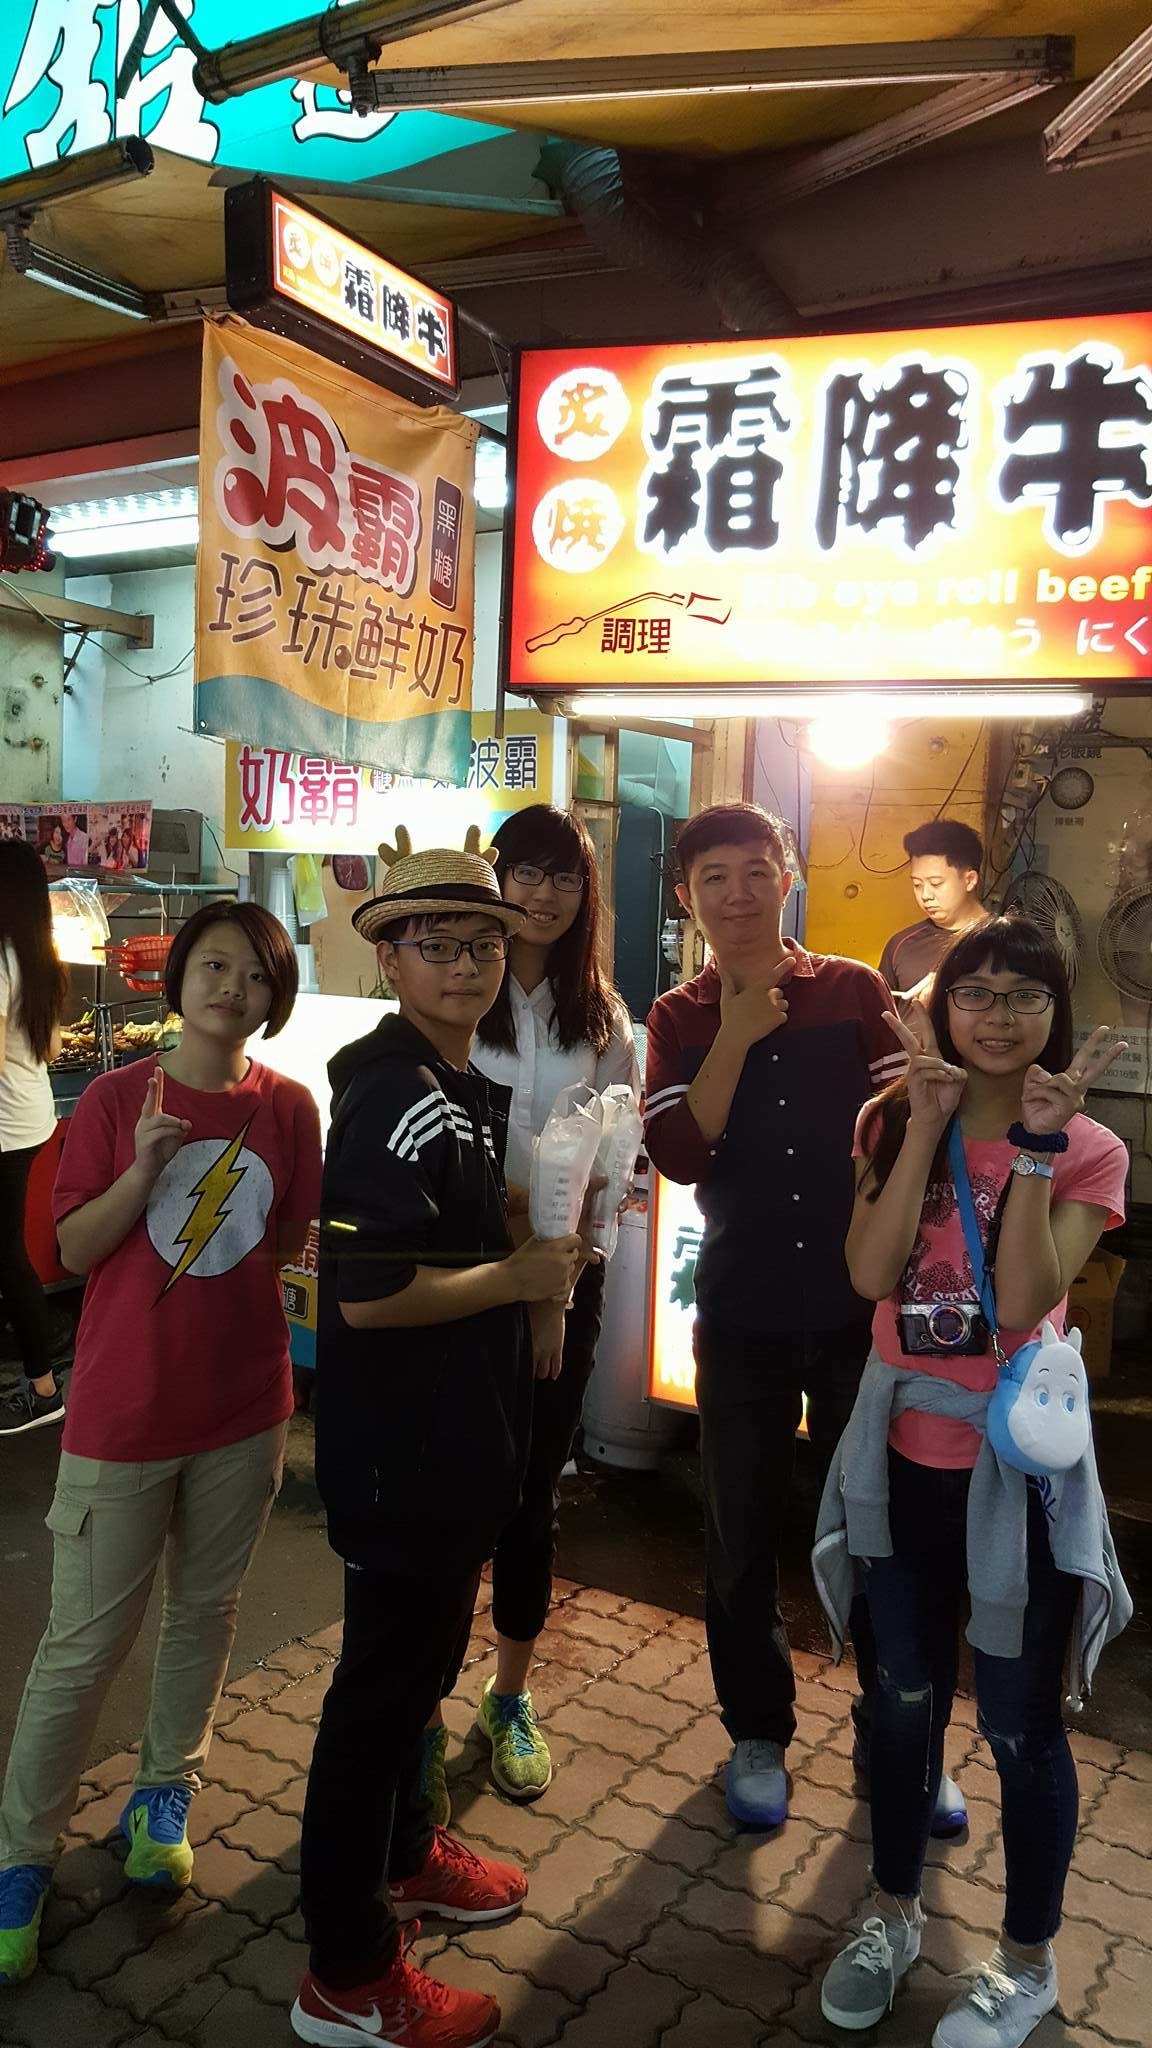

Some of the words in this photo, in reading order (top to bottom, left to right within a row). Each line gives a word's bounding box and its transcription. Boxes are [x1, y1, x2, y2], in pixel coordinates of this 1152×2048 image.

[344, 260, 447, 357] 霜降牛
[221, 371, 417, 586] 波霸
[643, 351, 1152, 555] 霜降牛
[433, 498, 458, 590] 黑糖
[833, 580, 919, 614] eye
[935, 569, 1019, 605] roll
[1035, 565, 1152, 604] beef
[208, 550, 468, 705] 珍珠鮮奶
[601, 617, 671, 654] 調理
[239, 745, 360, 827] 奶霸
